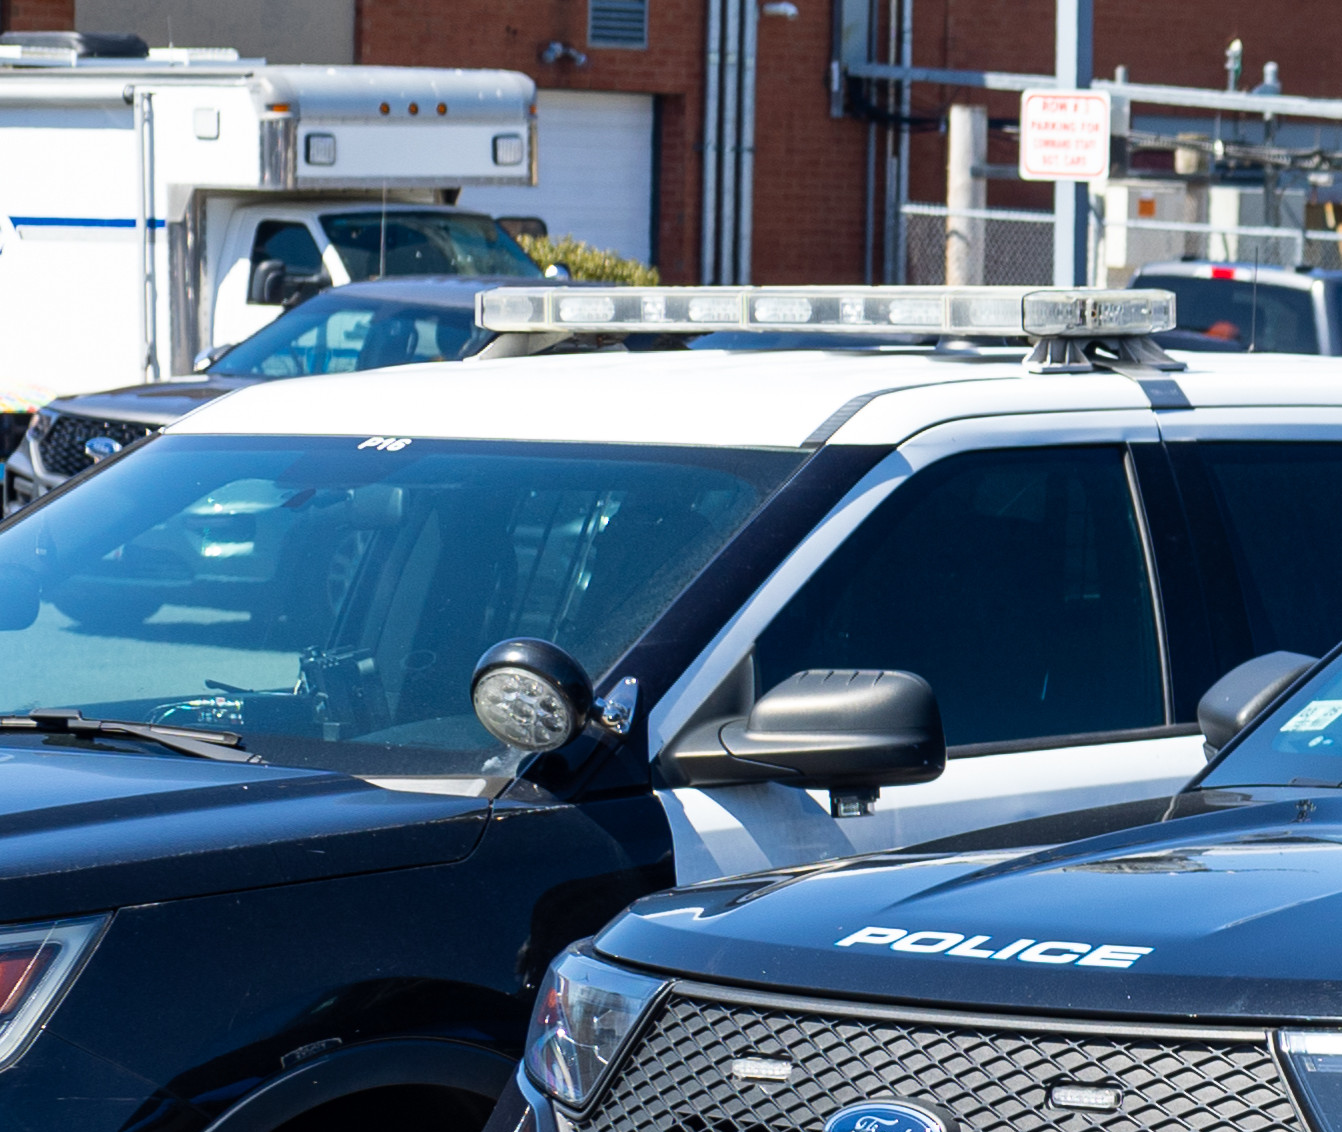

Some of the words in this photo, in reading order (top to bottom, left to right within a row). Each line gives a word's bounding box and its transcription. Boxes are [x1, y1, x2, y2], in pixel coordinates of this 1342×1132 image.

[1031, 120, 1075, 132] PARKING
[357, 437, 412, 451] P16
[834, 926, 1155, 968] POLICE
